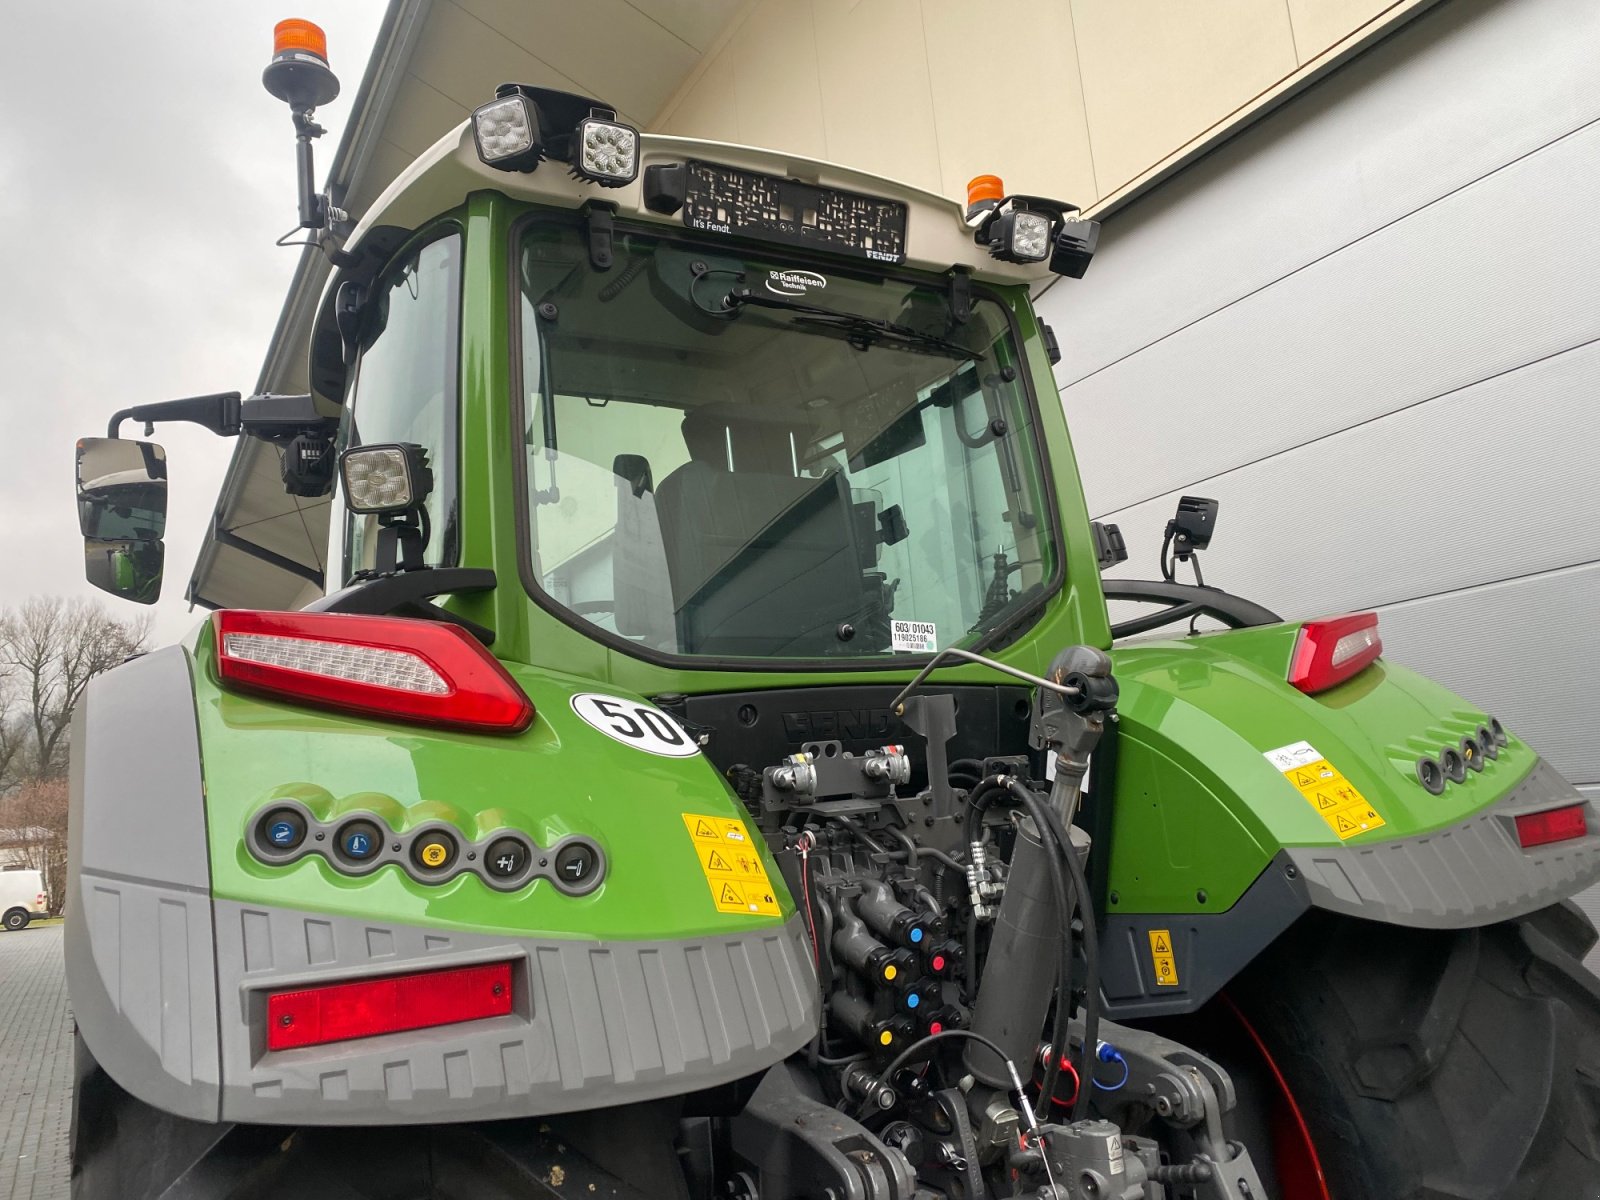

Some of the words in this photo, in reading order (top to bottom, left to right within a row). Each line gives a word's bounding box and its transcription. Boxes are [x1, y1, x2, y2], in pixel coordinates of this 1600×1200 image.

[692, 218, 705, 229] It's
[706, 221, 732, 234] Fendt.
[866, 249, 900, 262] FENDT
[779, 272, 823, 287] Raiffeisen
[780, 280, 807, 291] Technik
[589, 698, 685, 746] 50
[780, 708, 913, 745] FEND
